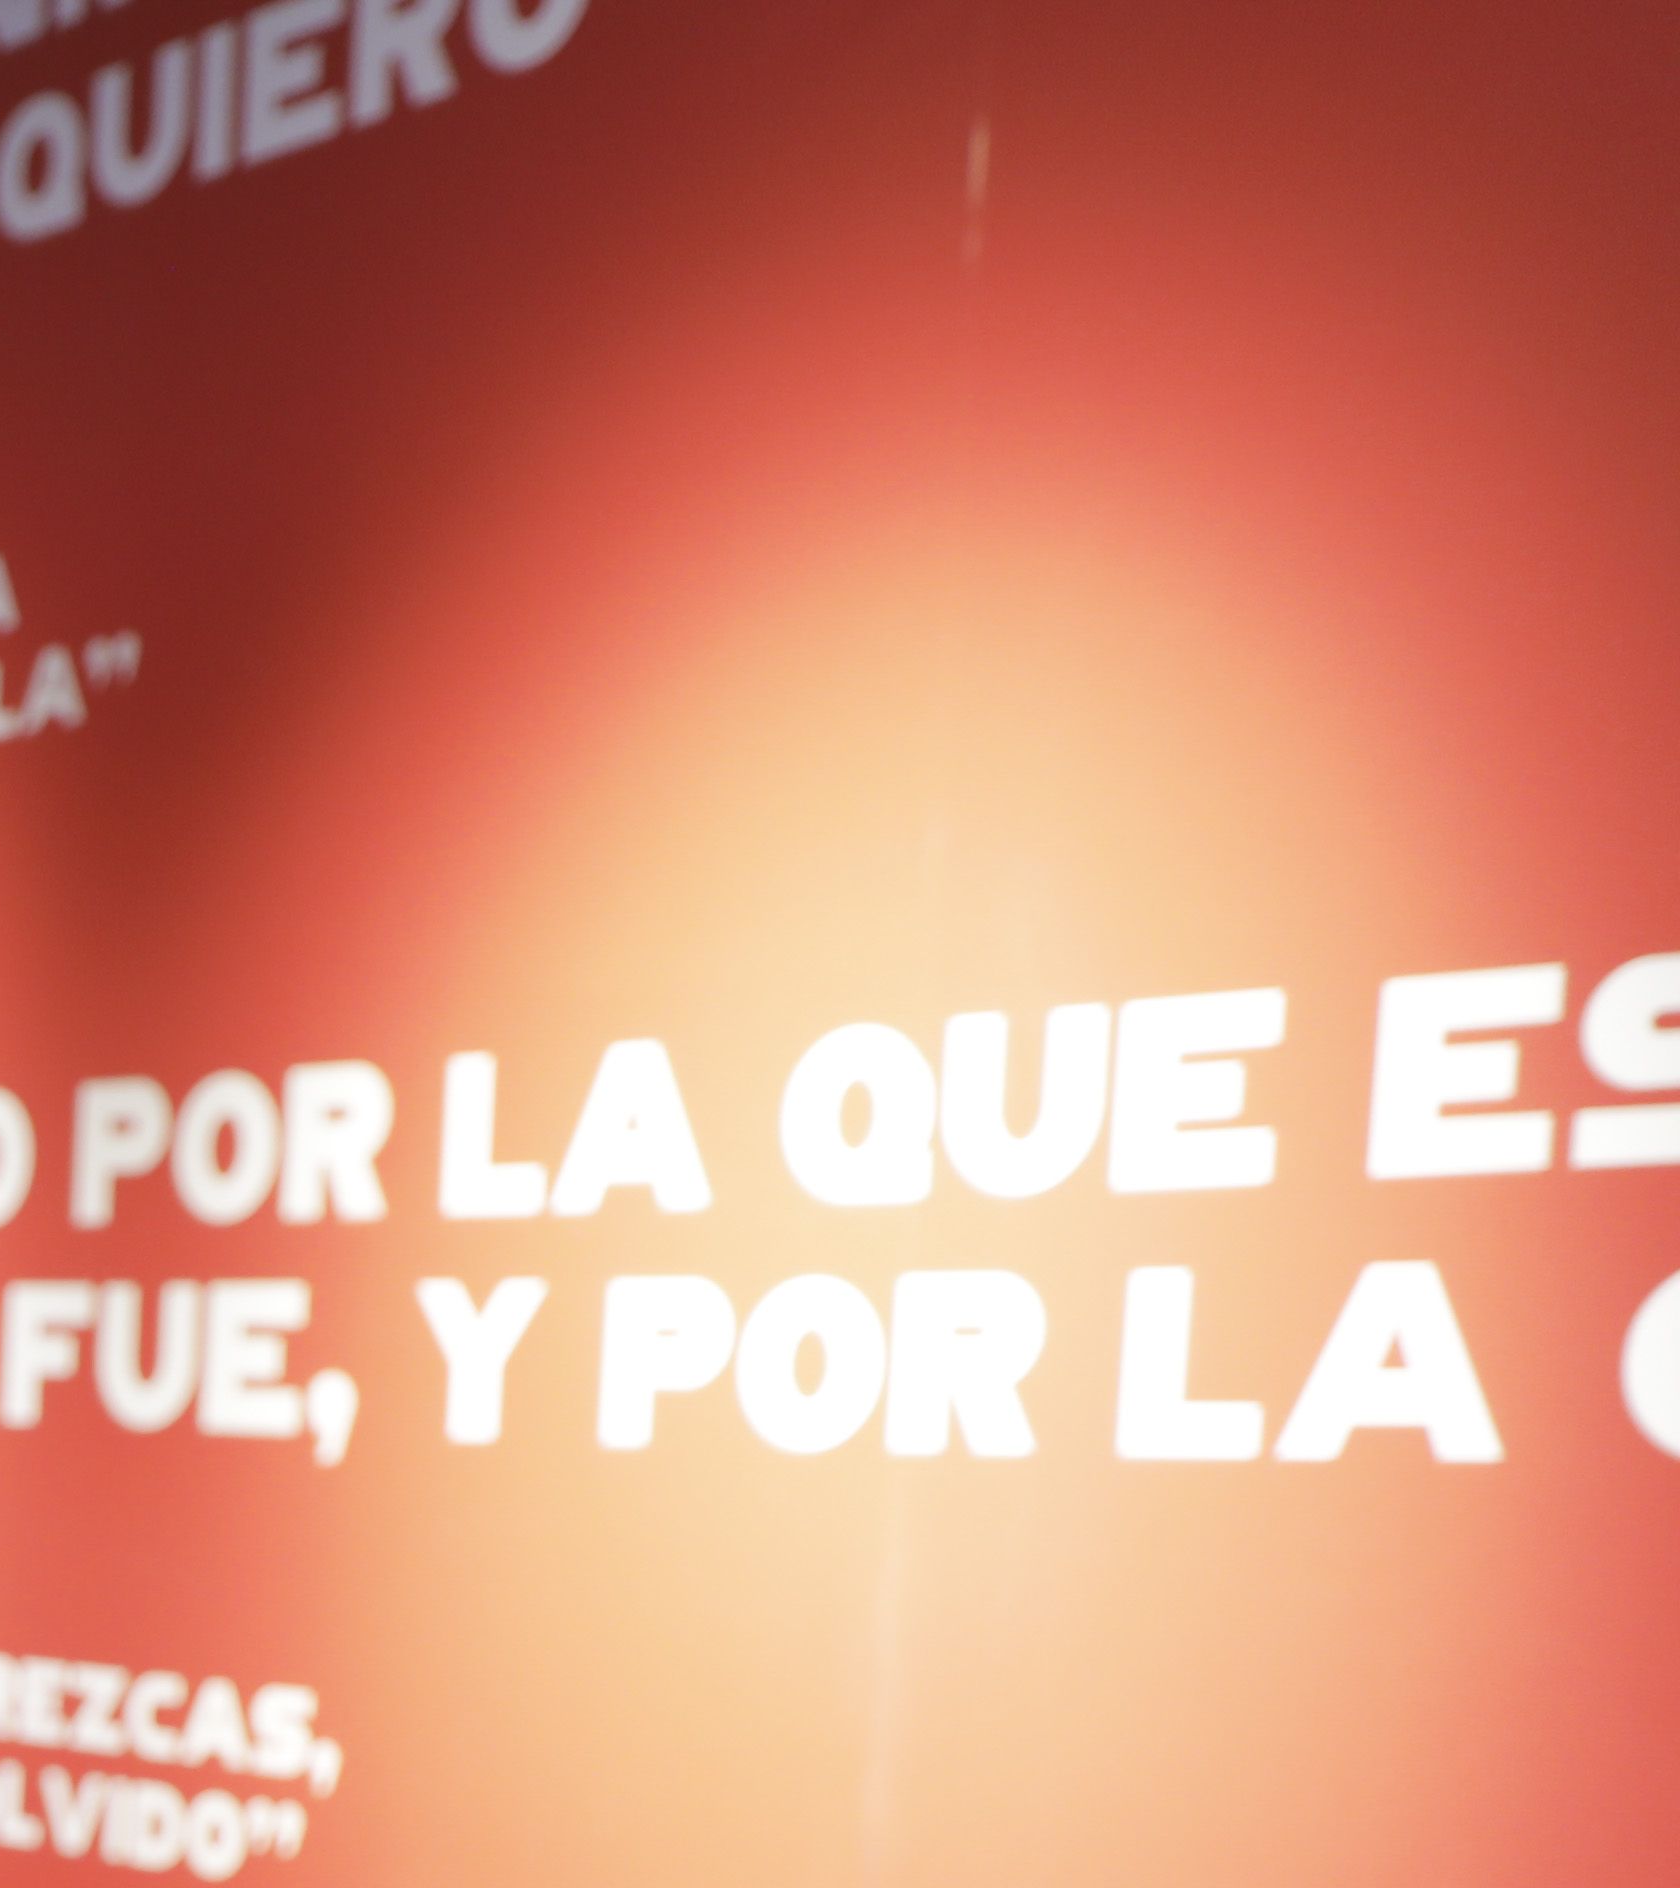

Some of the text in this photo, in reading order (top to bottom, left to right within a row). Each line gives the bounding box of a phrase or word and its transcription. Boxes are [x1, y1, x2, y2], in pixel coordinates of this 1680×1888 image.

[67, 1060, 396, 1232] POR
[440, 1038, 714, 1218] LA
[779, 987, 1287, 1209] QUE
[415, 1275, 551, 1447] Y
[598, 1268, 1050, 1461] POR
[1114, 1258, 1507, 1466] LA
